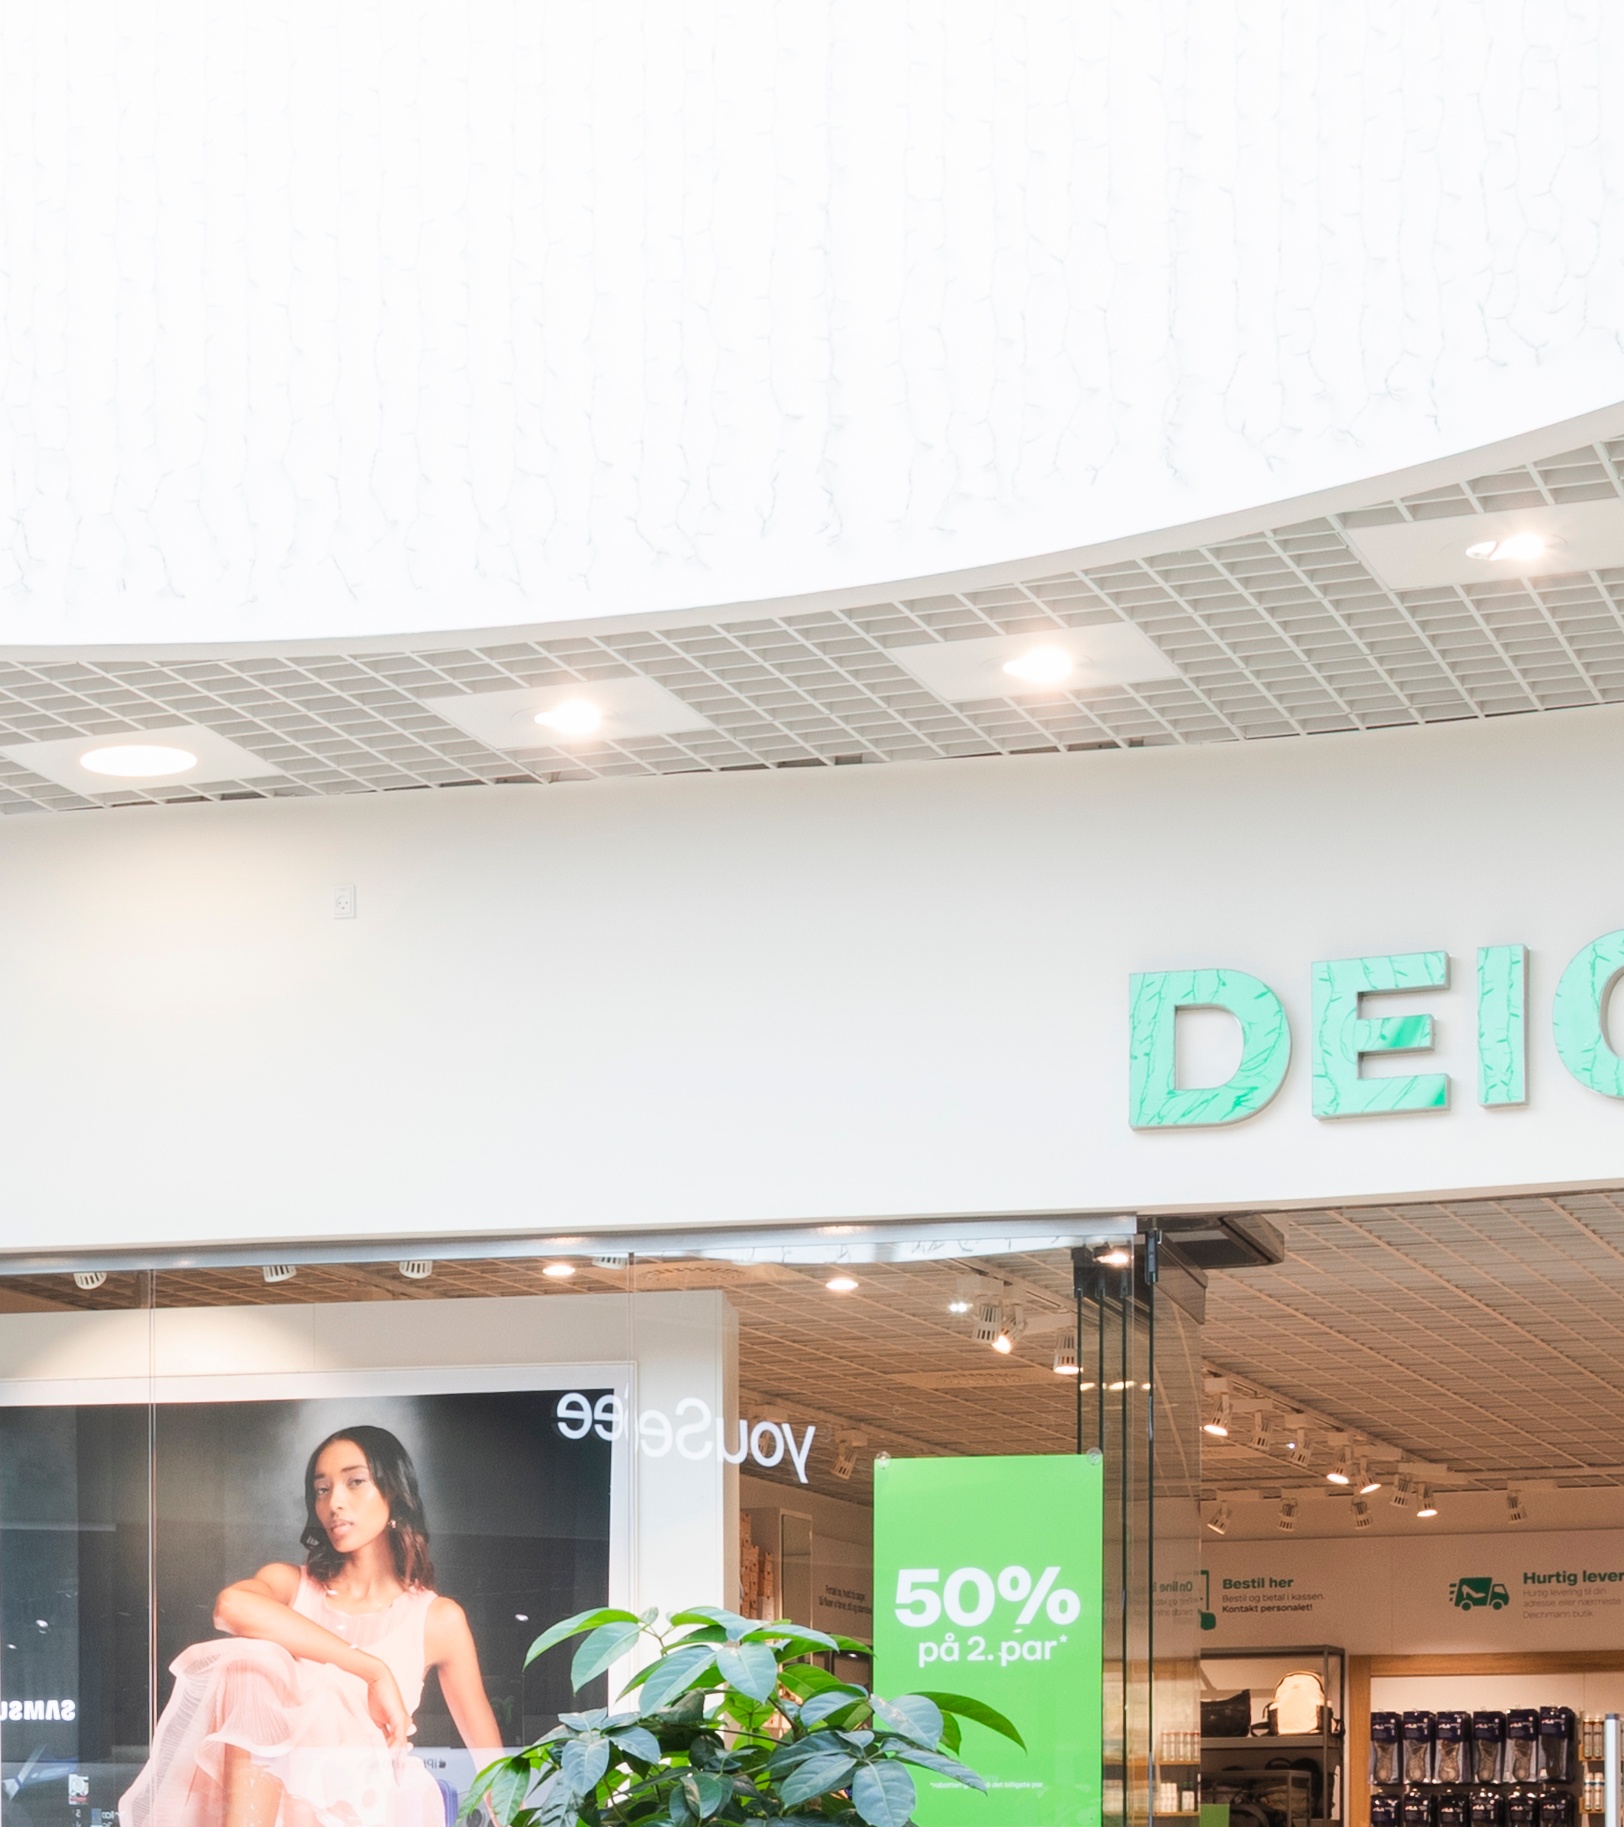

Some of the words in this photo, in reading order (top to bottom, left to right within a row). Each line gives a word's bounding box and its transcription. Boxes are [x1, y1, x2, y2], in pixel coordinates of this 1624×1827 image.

[1222, 1577, 1265, 1590] Bestil
[1269, 1577, 1294, 1588] her
[1523, 1571, 1578, 1586] Hurtig
[894, 1565, 1081, 1628] 50%
[1222, 1594, 1247, 1603] Bestil
[1248, 1595, 1261, 1603] og
[1262, 1594, 1285, 1602] betal
[1222, 1605, 1259, 1613] Kontakt
[1261, 1603, 1313, 1613] personalet!
[918, 1632, 960, 1669] på
[966, 1635, 995, 1661] 2.
